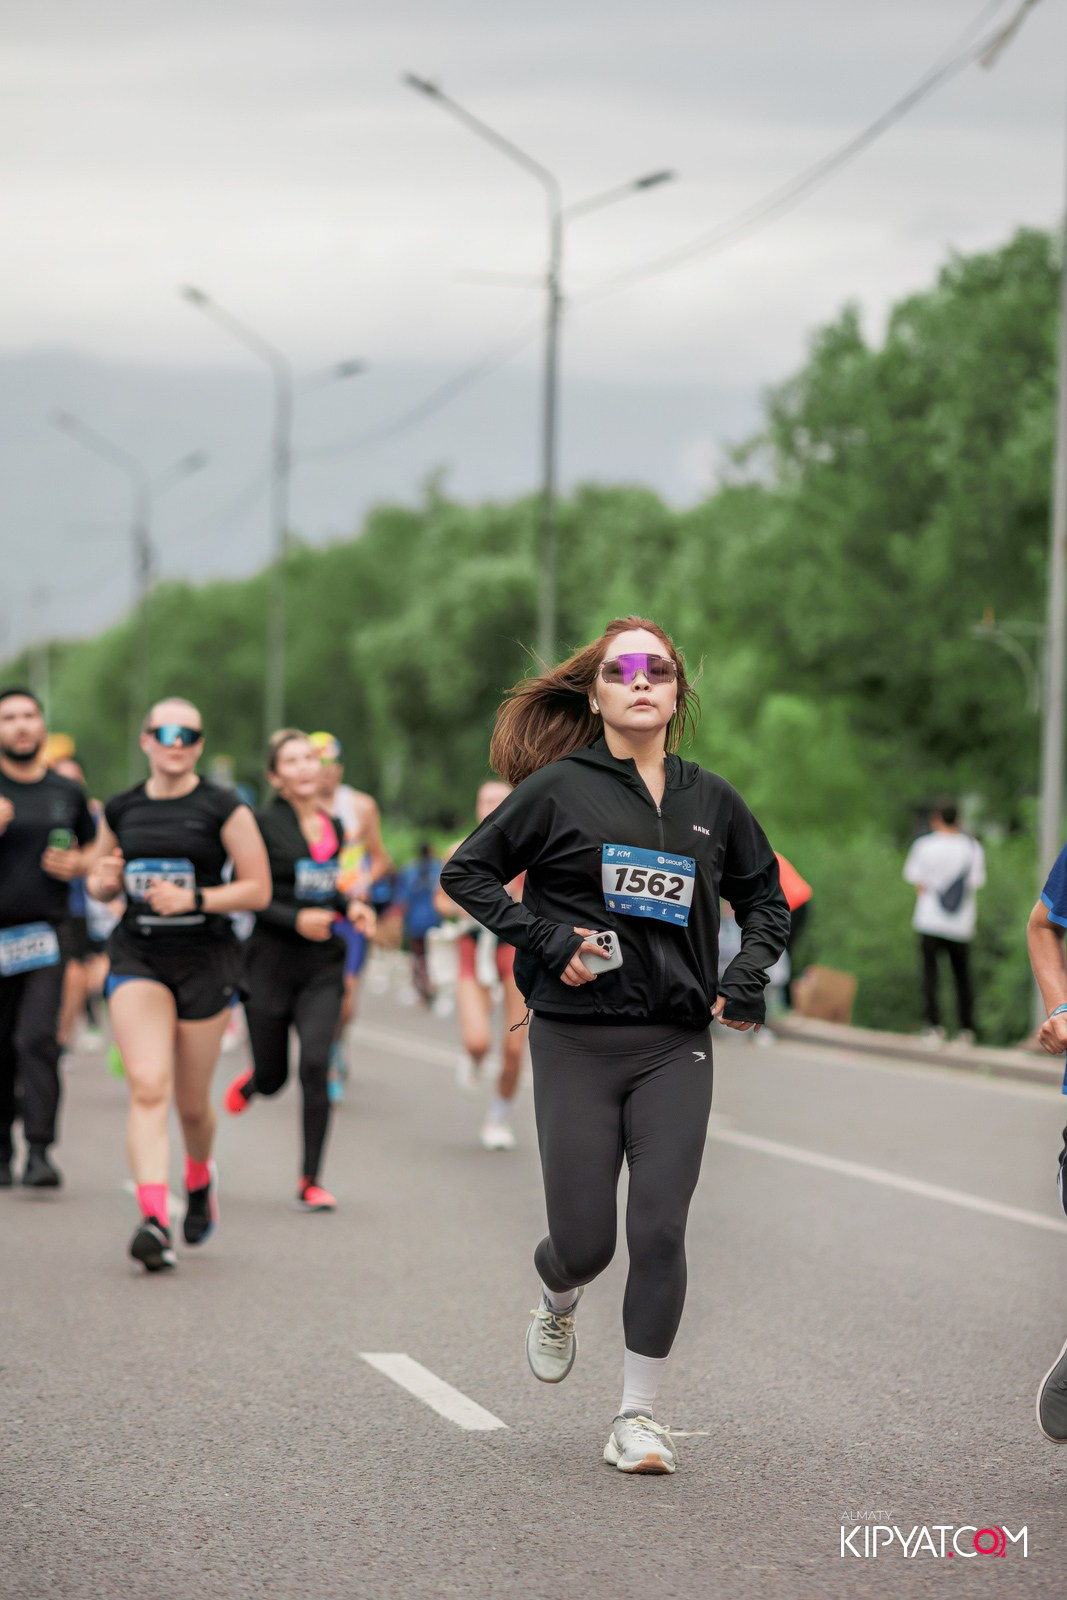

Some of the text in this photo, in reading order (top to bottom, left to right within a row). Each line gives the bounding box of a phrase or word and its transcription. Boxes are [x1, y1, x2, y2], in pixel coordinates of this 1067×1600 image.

[607, 848, 631, 858] 5 KM
[615, 867, 684, 901] 1562
